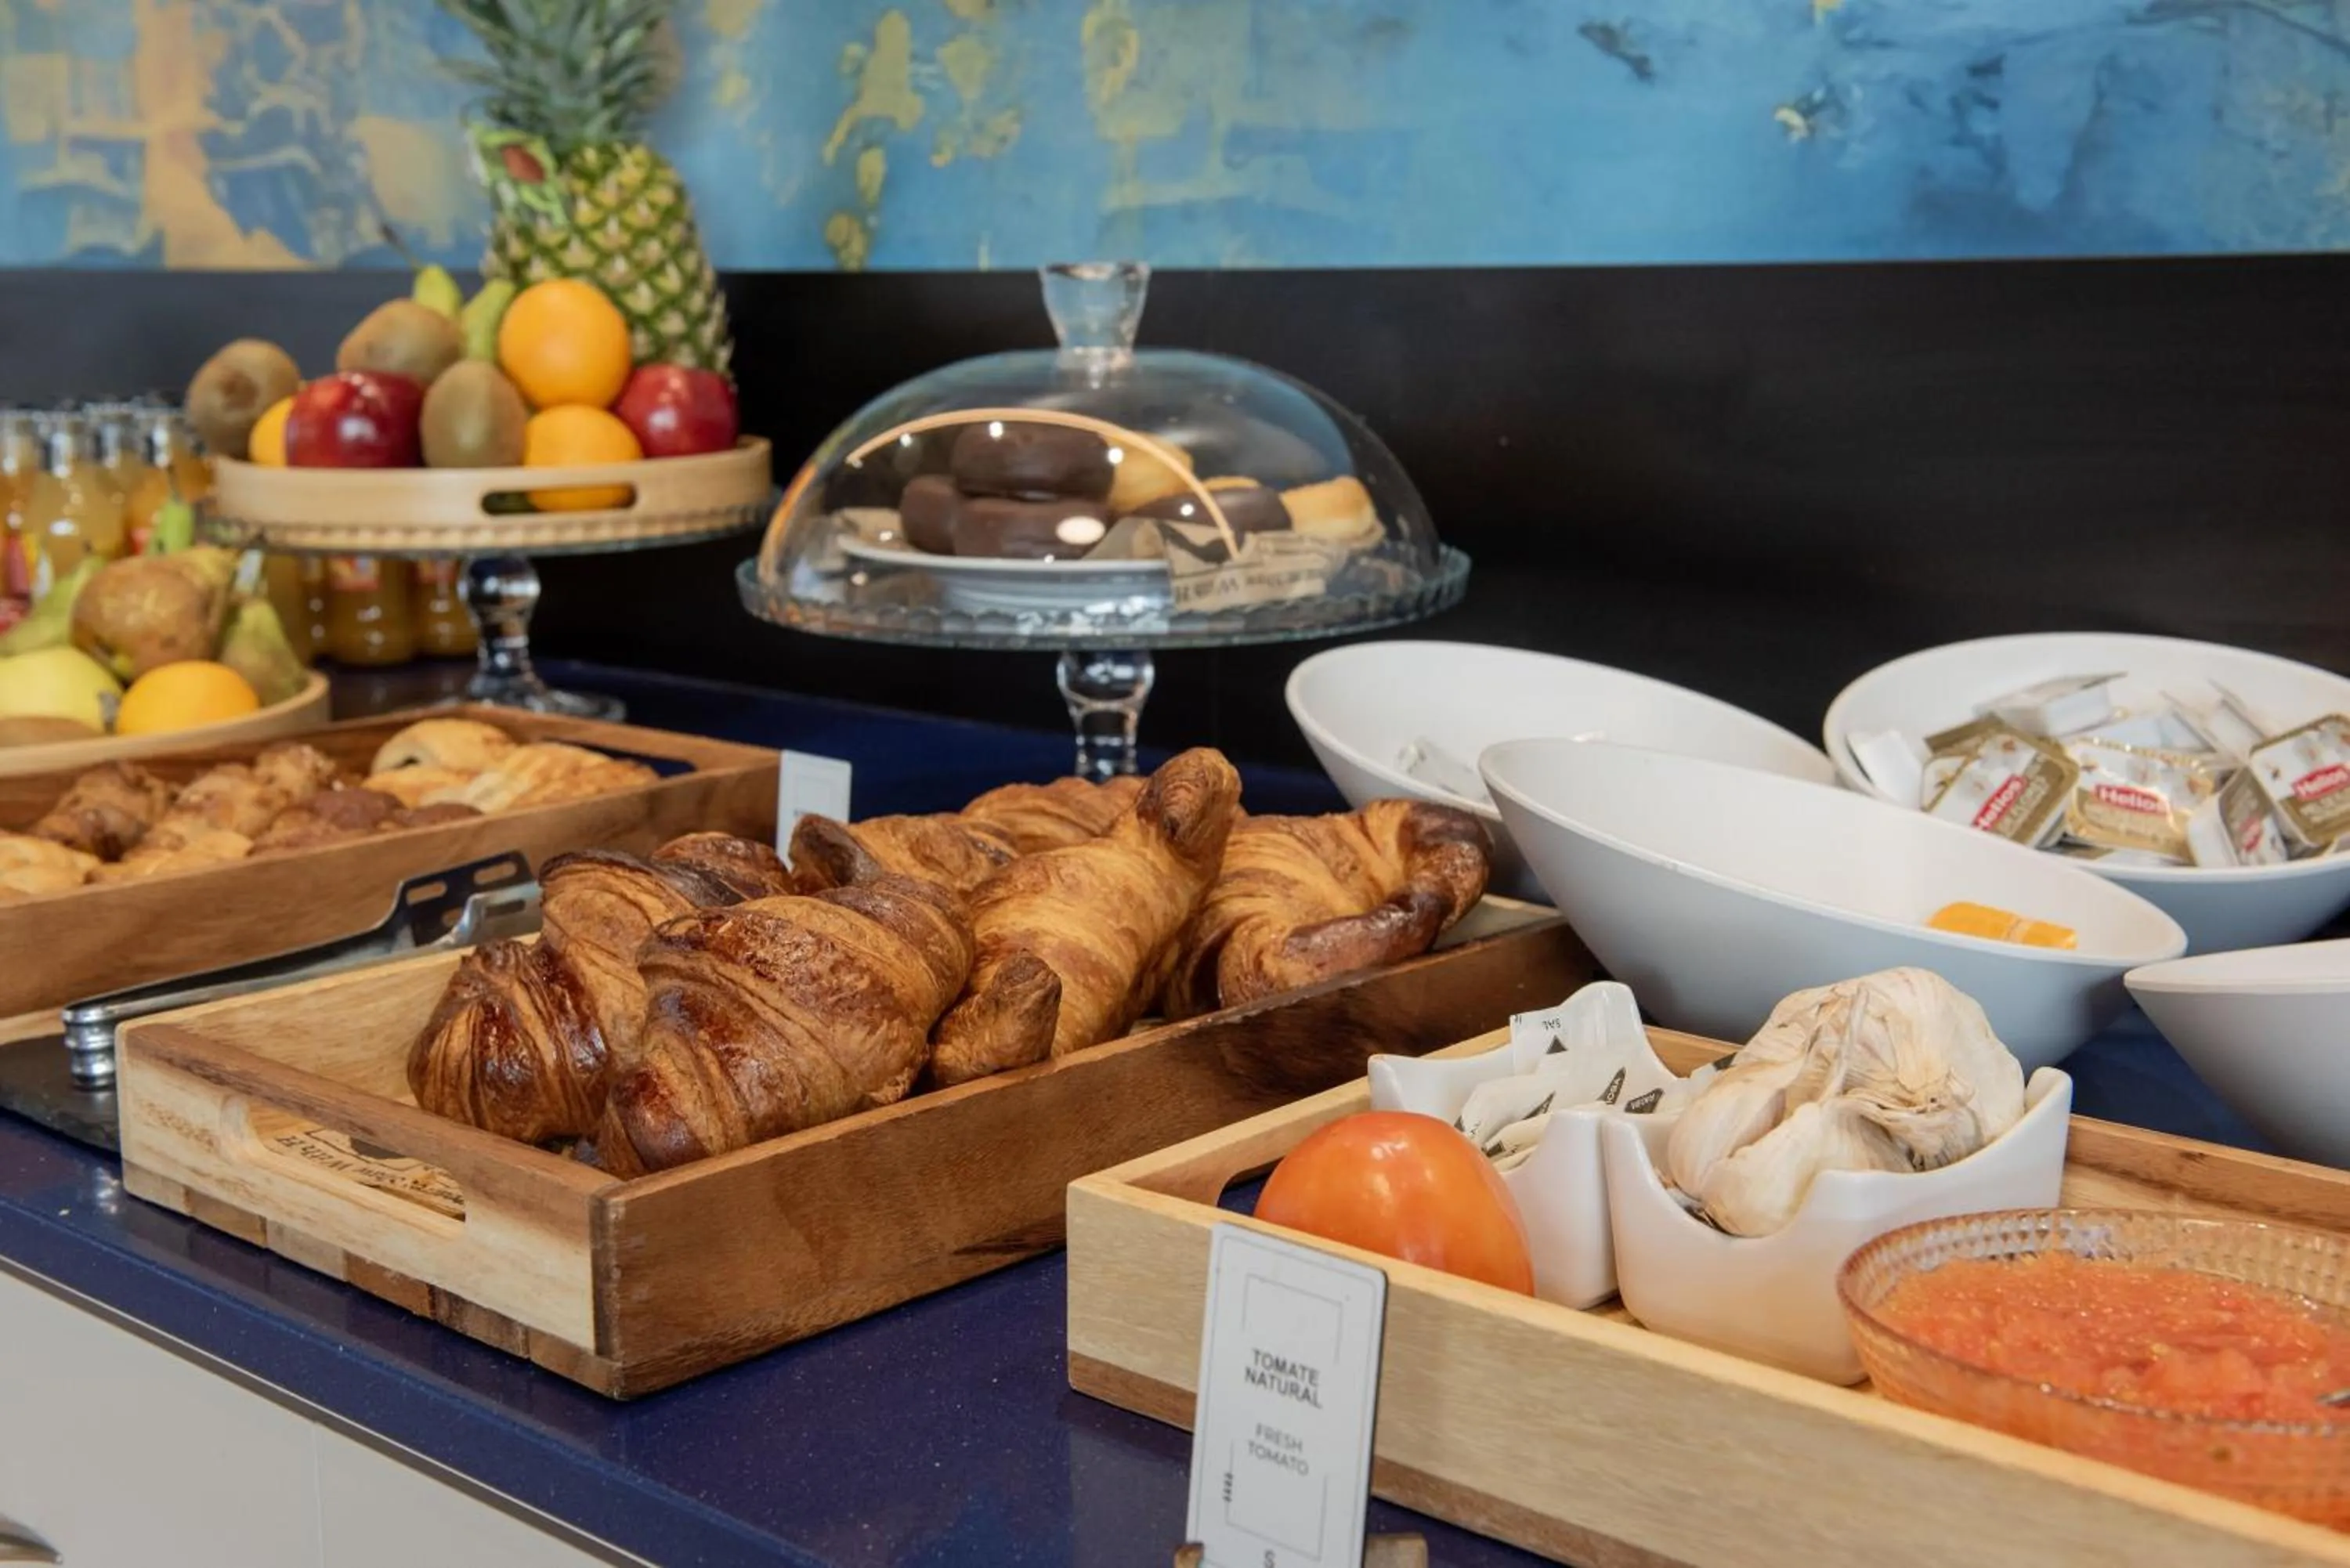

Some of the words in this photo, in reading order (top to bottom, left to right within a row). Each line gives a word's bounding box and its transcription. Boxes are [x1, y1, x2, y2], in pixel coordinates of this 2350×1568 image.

[2296, 768, 2348, 797] Helios
[1253, 1348, 1320, 1387] TOMATE
[1245, 1367, 1323, 1409] NATURAL
[1256, 1423, 1303, 1453] FRESH
[1249, 1440, 1309, 1476] TOMATO
